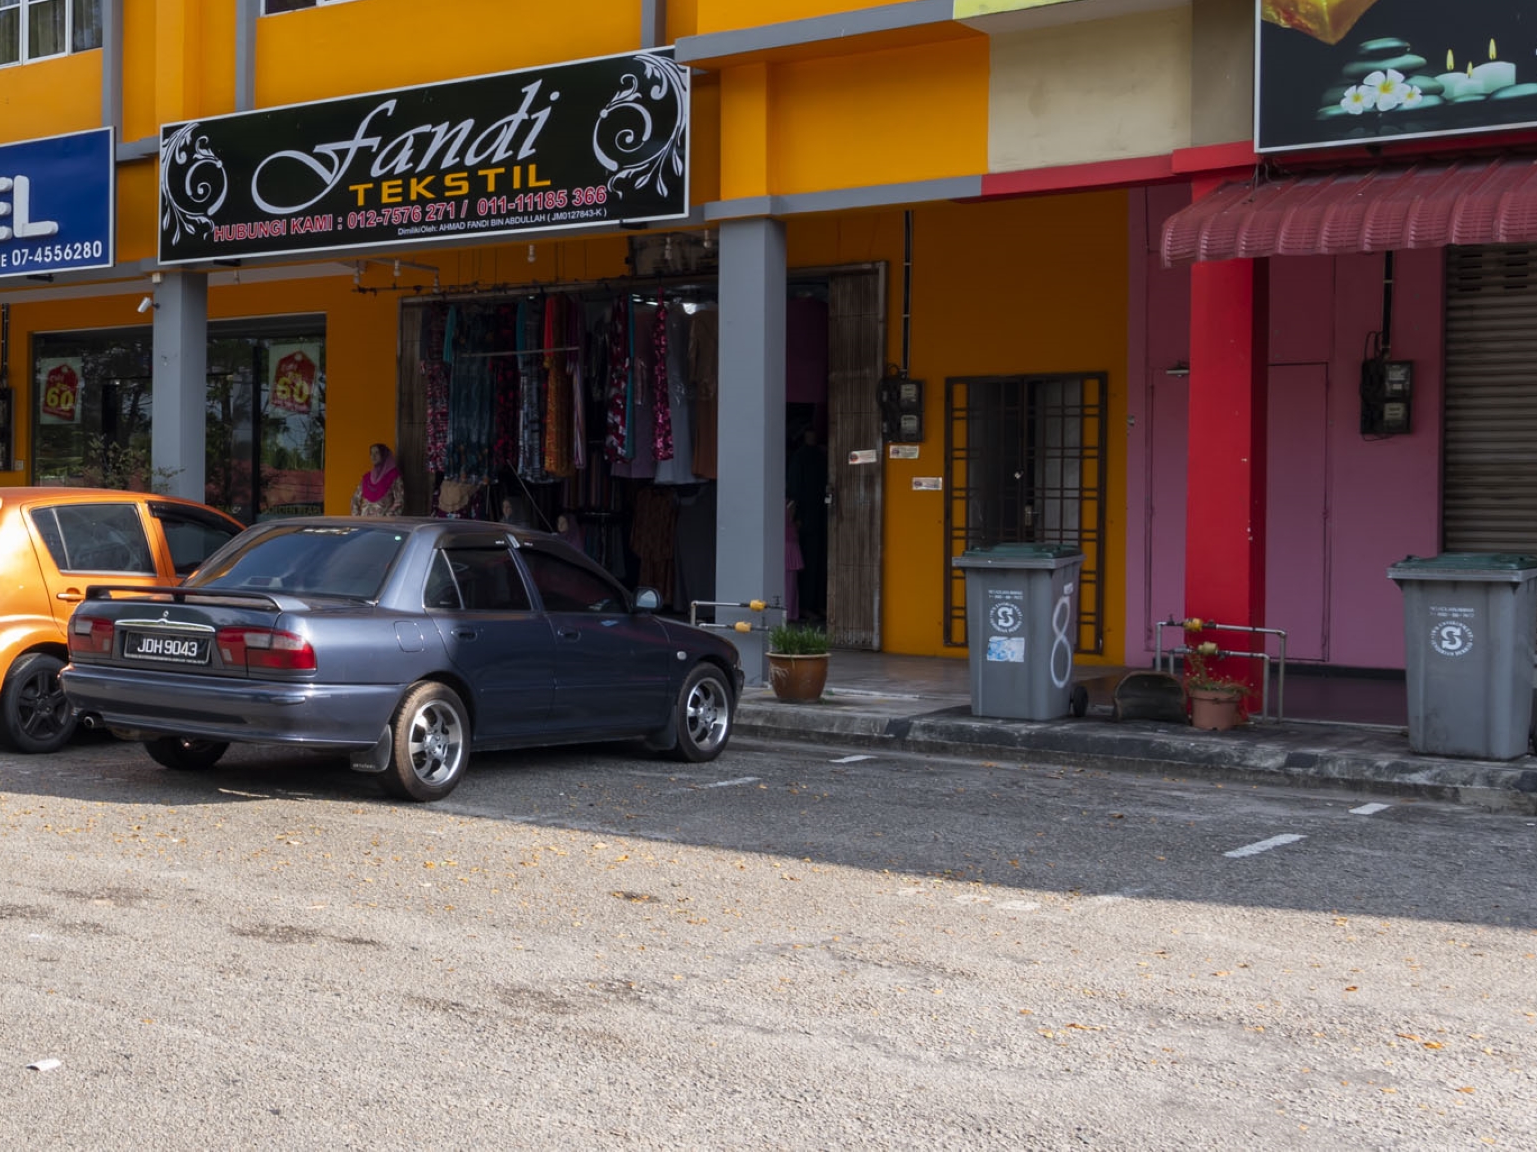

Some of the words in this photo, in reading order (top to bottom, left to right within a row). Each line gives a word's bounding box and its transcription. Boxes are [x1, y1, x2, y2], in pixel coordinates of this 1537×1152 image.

[349, 165, 551, 207] TEKSTIL
[213, 220, 286, 243] HUBUNGI
[290, 214, 333, 236] KAMI
[347, 204, 422, 229] 012-7576
[425, 201, 456, 223] 271
[477, 191, 568, 217] 011-11185
[571, 185, 607, 207] 366
[439, 222, 466, 232] AHMAD
[467, 220, 489, 229] FANDI
[491, 218, 504, 227] BIN
[11, 240, 103, 266] 07-4556280
[137, 638, 163, 654] JDH
[164, 640, 198, 657] 9043
